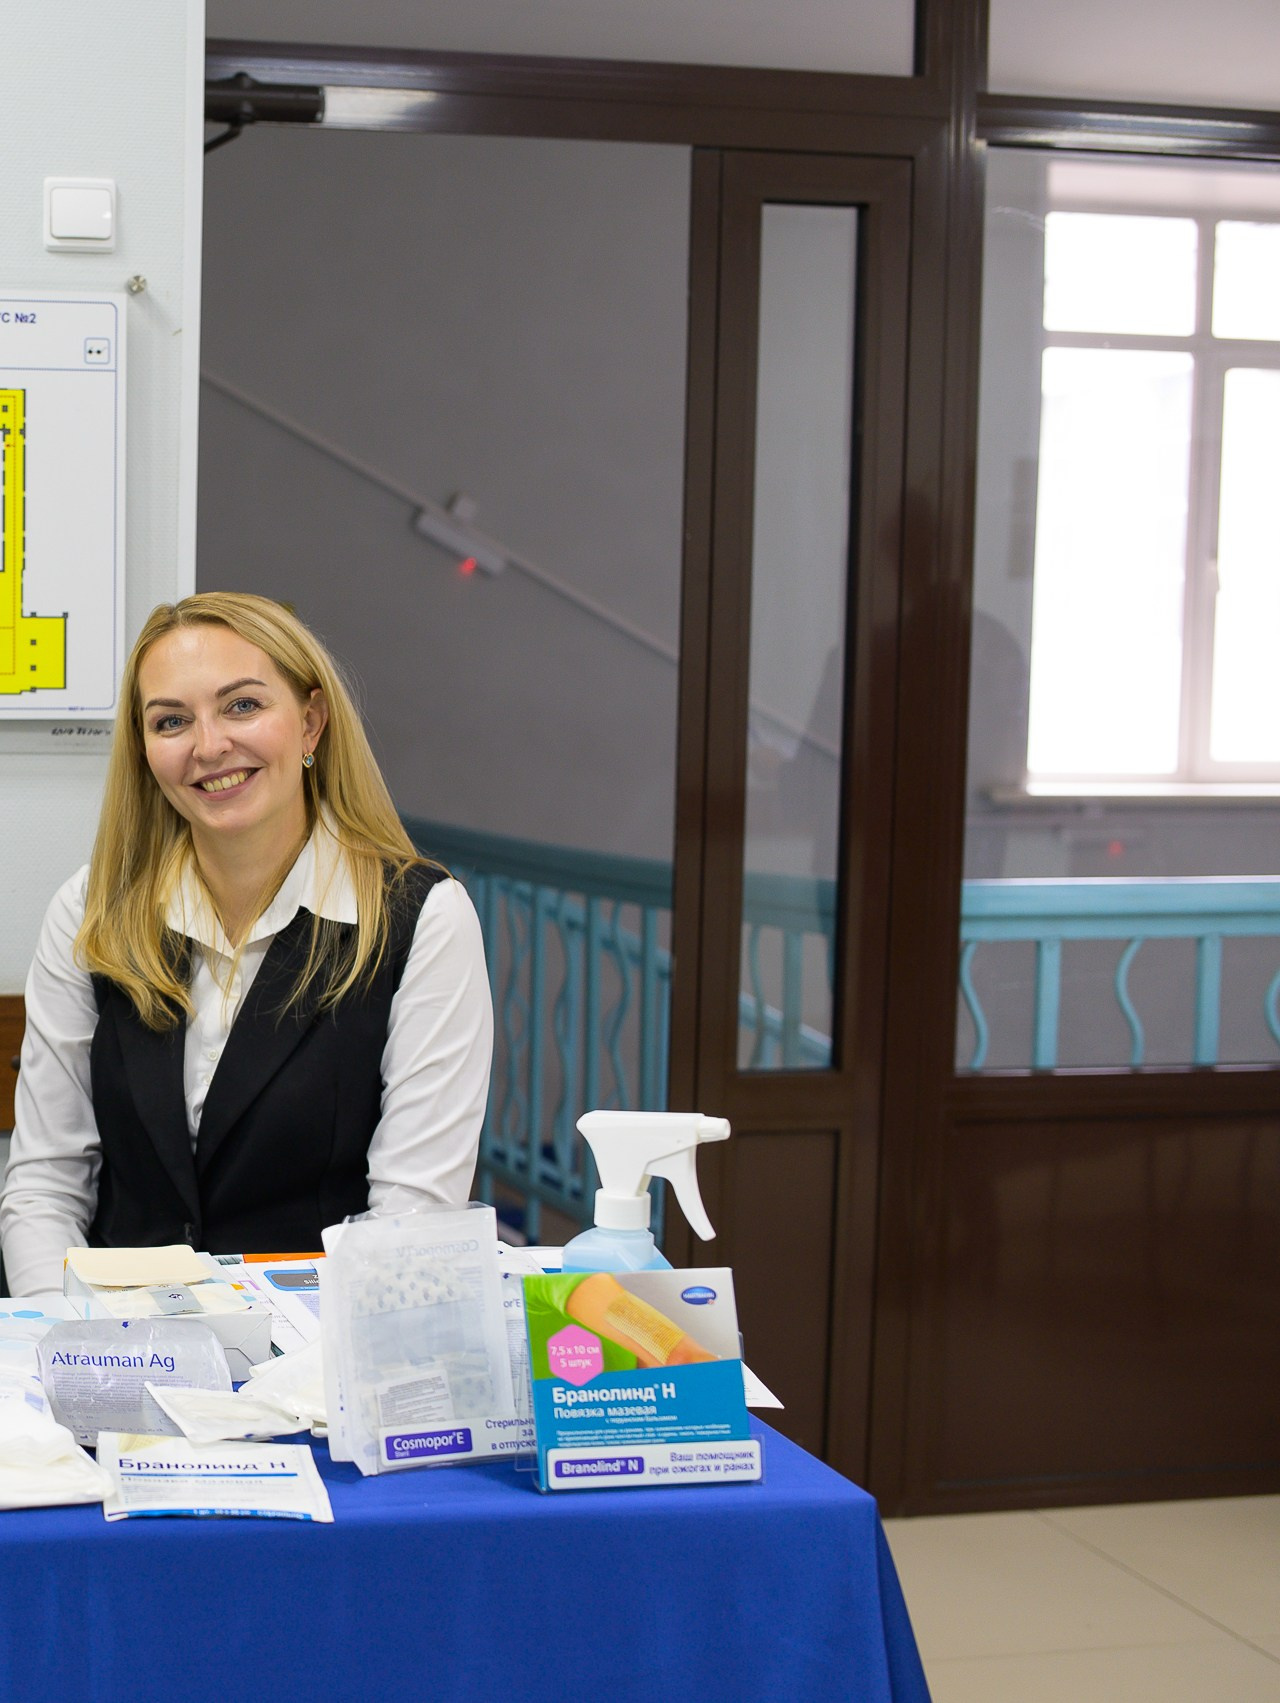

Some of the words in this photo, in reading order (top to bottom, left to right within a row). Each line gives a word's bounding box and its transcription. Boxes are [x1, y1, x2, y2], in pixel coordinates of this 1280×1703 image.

[15, 313, 36, 324] №2
[574, 1345, 585, 1355] 10
[150, 1354, 175, 1372] Ag
[568, 1359, 592, 1370] штук
[554, 1407, 605, 1419] Повязка
[608, 1406, 657, 1416] мазевая
[671, 1452, 693, 1462] Ваш
[696, 1451, 754, 1461] помощник
[119, 1458, 258, 1470] Бранолинд
[628, 1459, 639, 1471] N
[650, 1466, 669, 1475] при
[672, 1464, 711, 1473] ожогах
[714, 1464, 721, 1472] и
[724, 1463, 755, 1474] ранах
